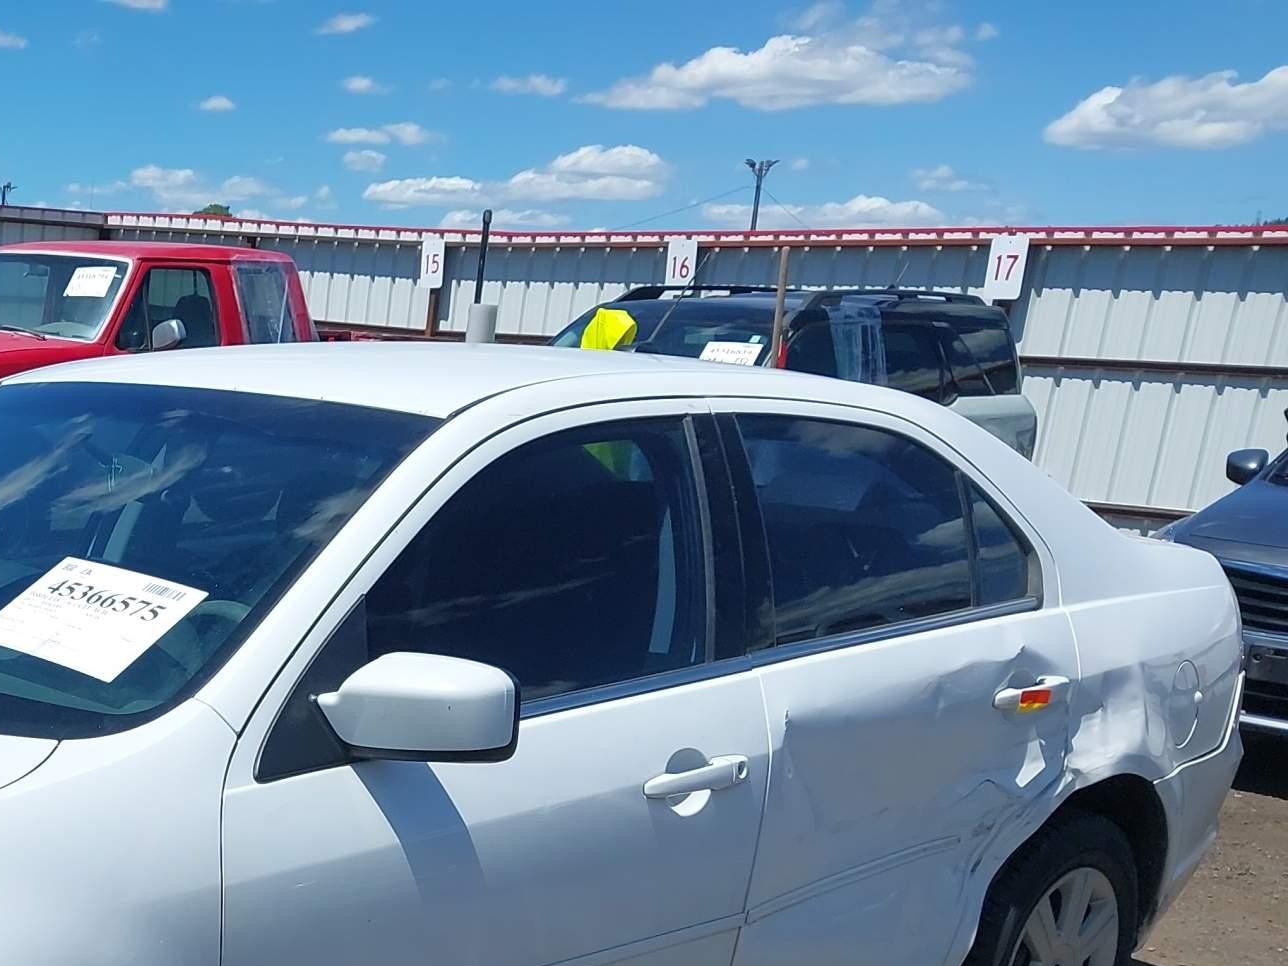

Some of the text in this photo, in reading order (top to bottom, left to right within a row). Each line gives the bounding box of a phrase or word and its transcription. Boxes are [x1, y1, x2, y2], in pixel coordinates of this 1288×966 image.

[425, 253, 440, 275] 15
[672, 255, 690, 279] 16
[994, 254, 1020, 281] 17
[48, 579, 167, 622] 45366575
